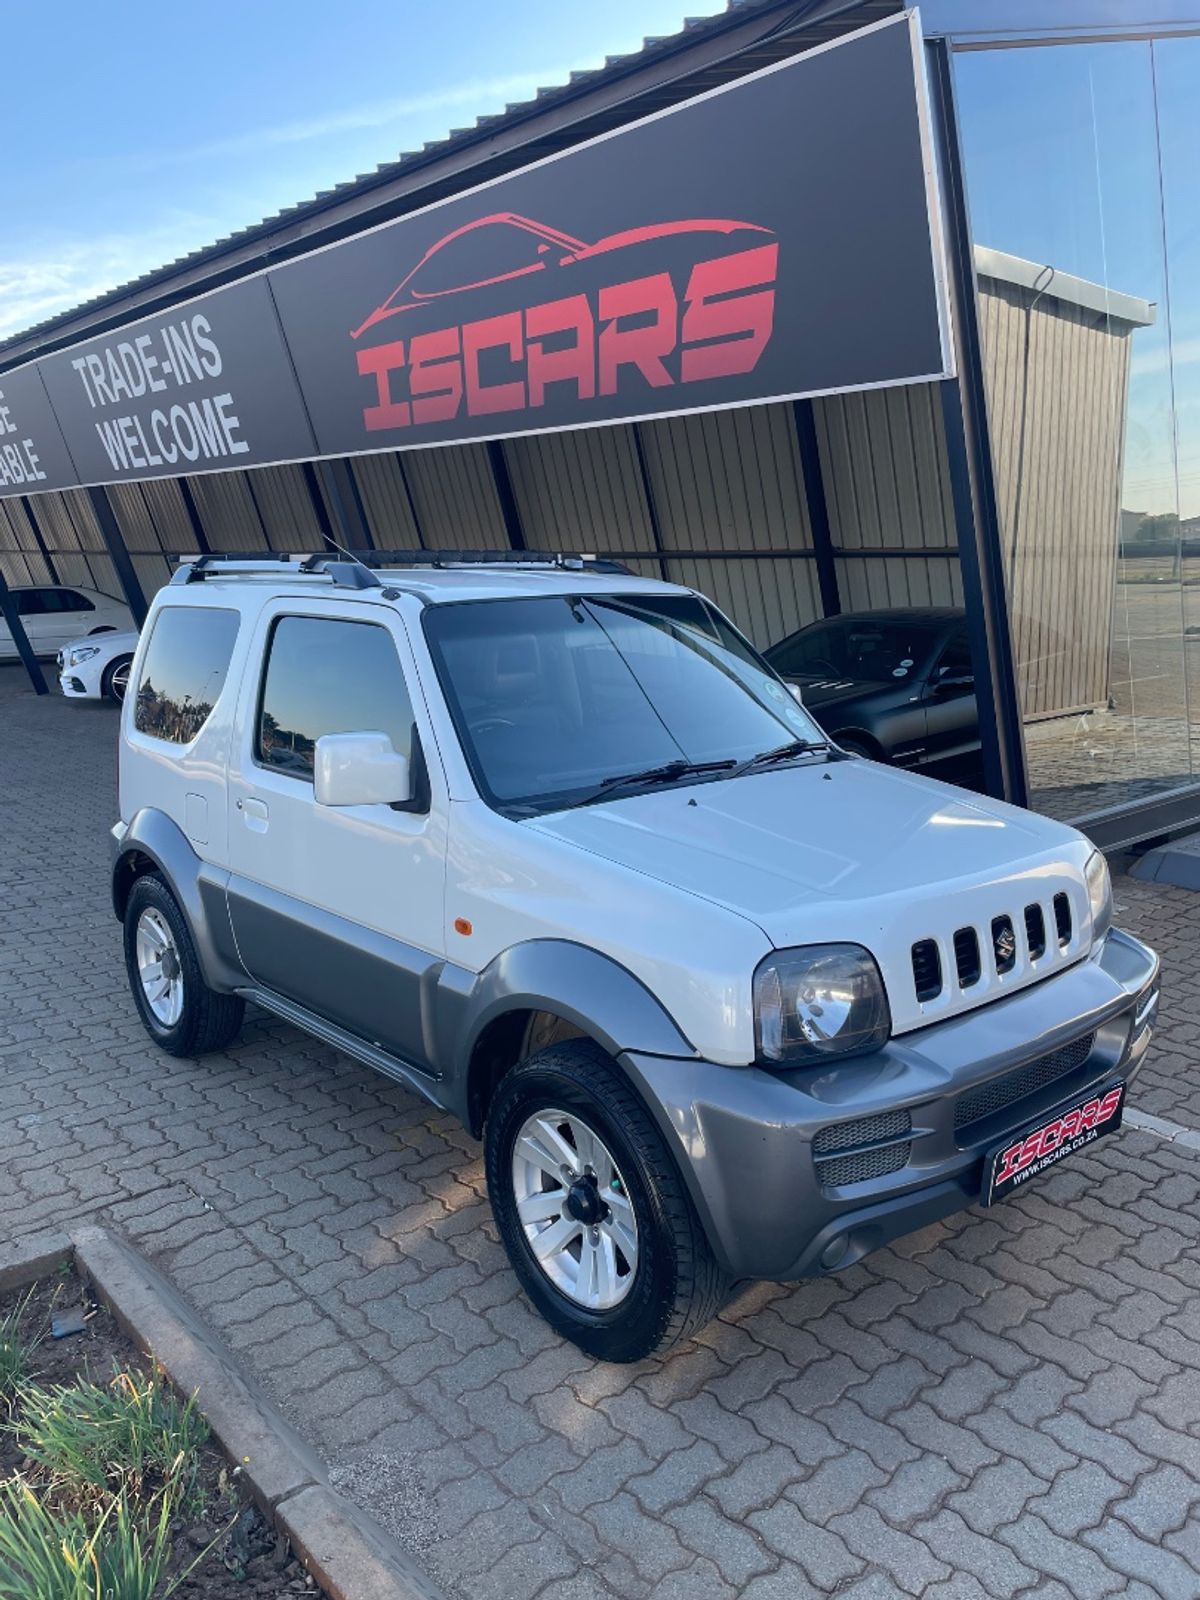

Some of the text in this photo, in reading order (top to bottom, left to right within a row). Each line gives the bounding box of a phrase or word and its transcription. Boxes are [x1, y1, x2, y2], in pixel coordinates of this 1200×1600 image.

[71, 313, 223, 408] TRADE-INS
[356, 242, 779, 432] ISCARS
[0, 438, 47, 486] ABLE
[95, 392, 250, 471] WELCOME
[995, 1086, 1123, 1187] ISCARS
